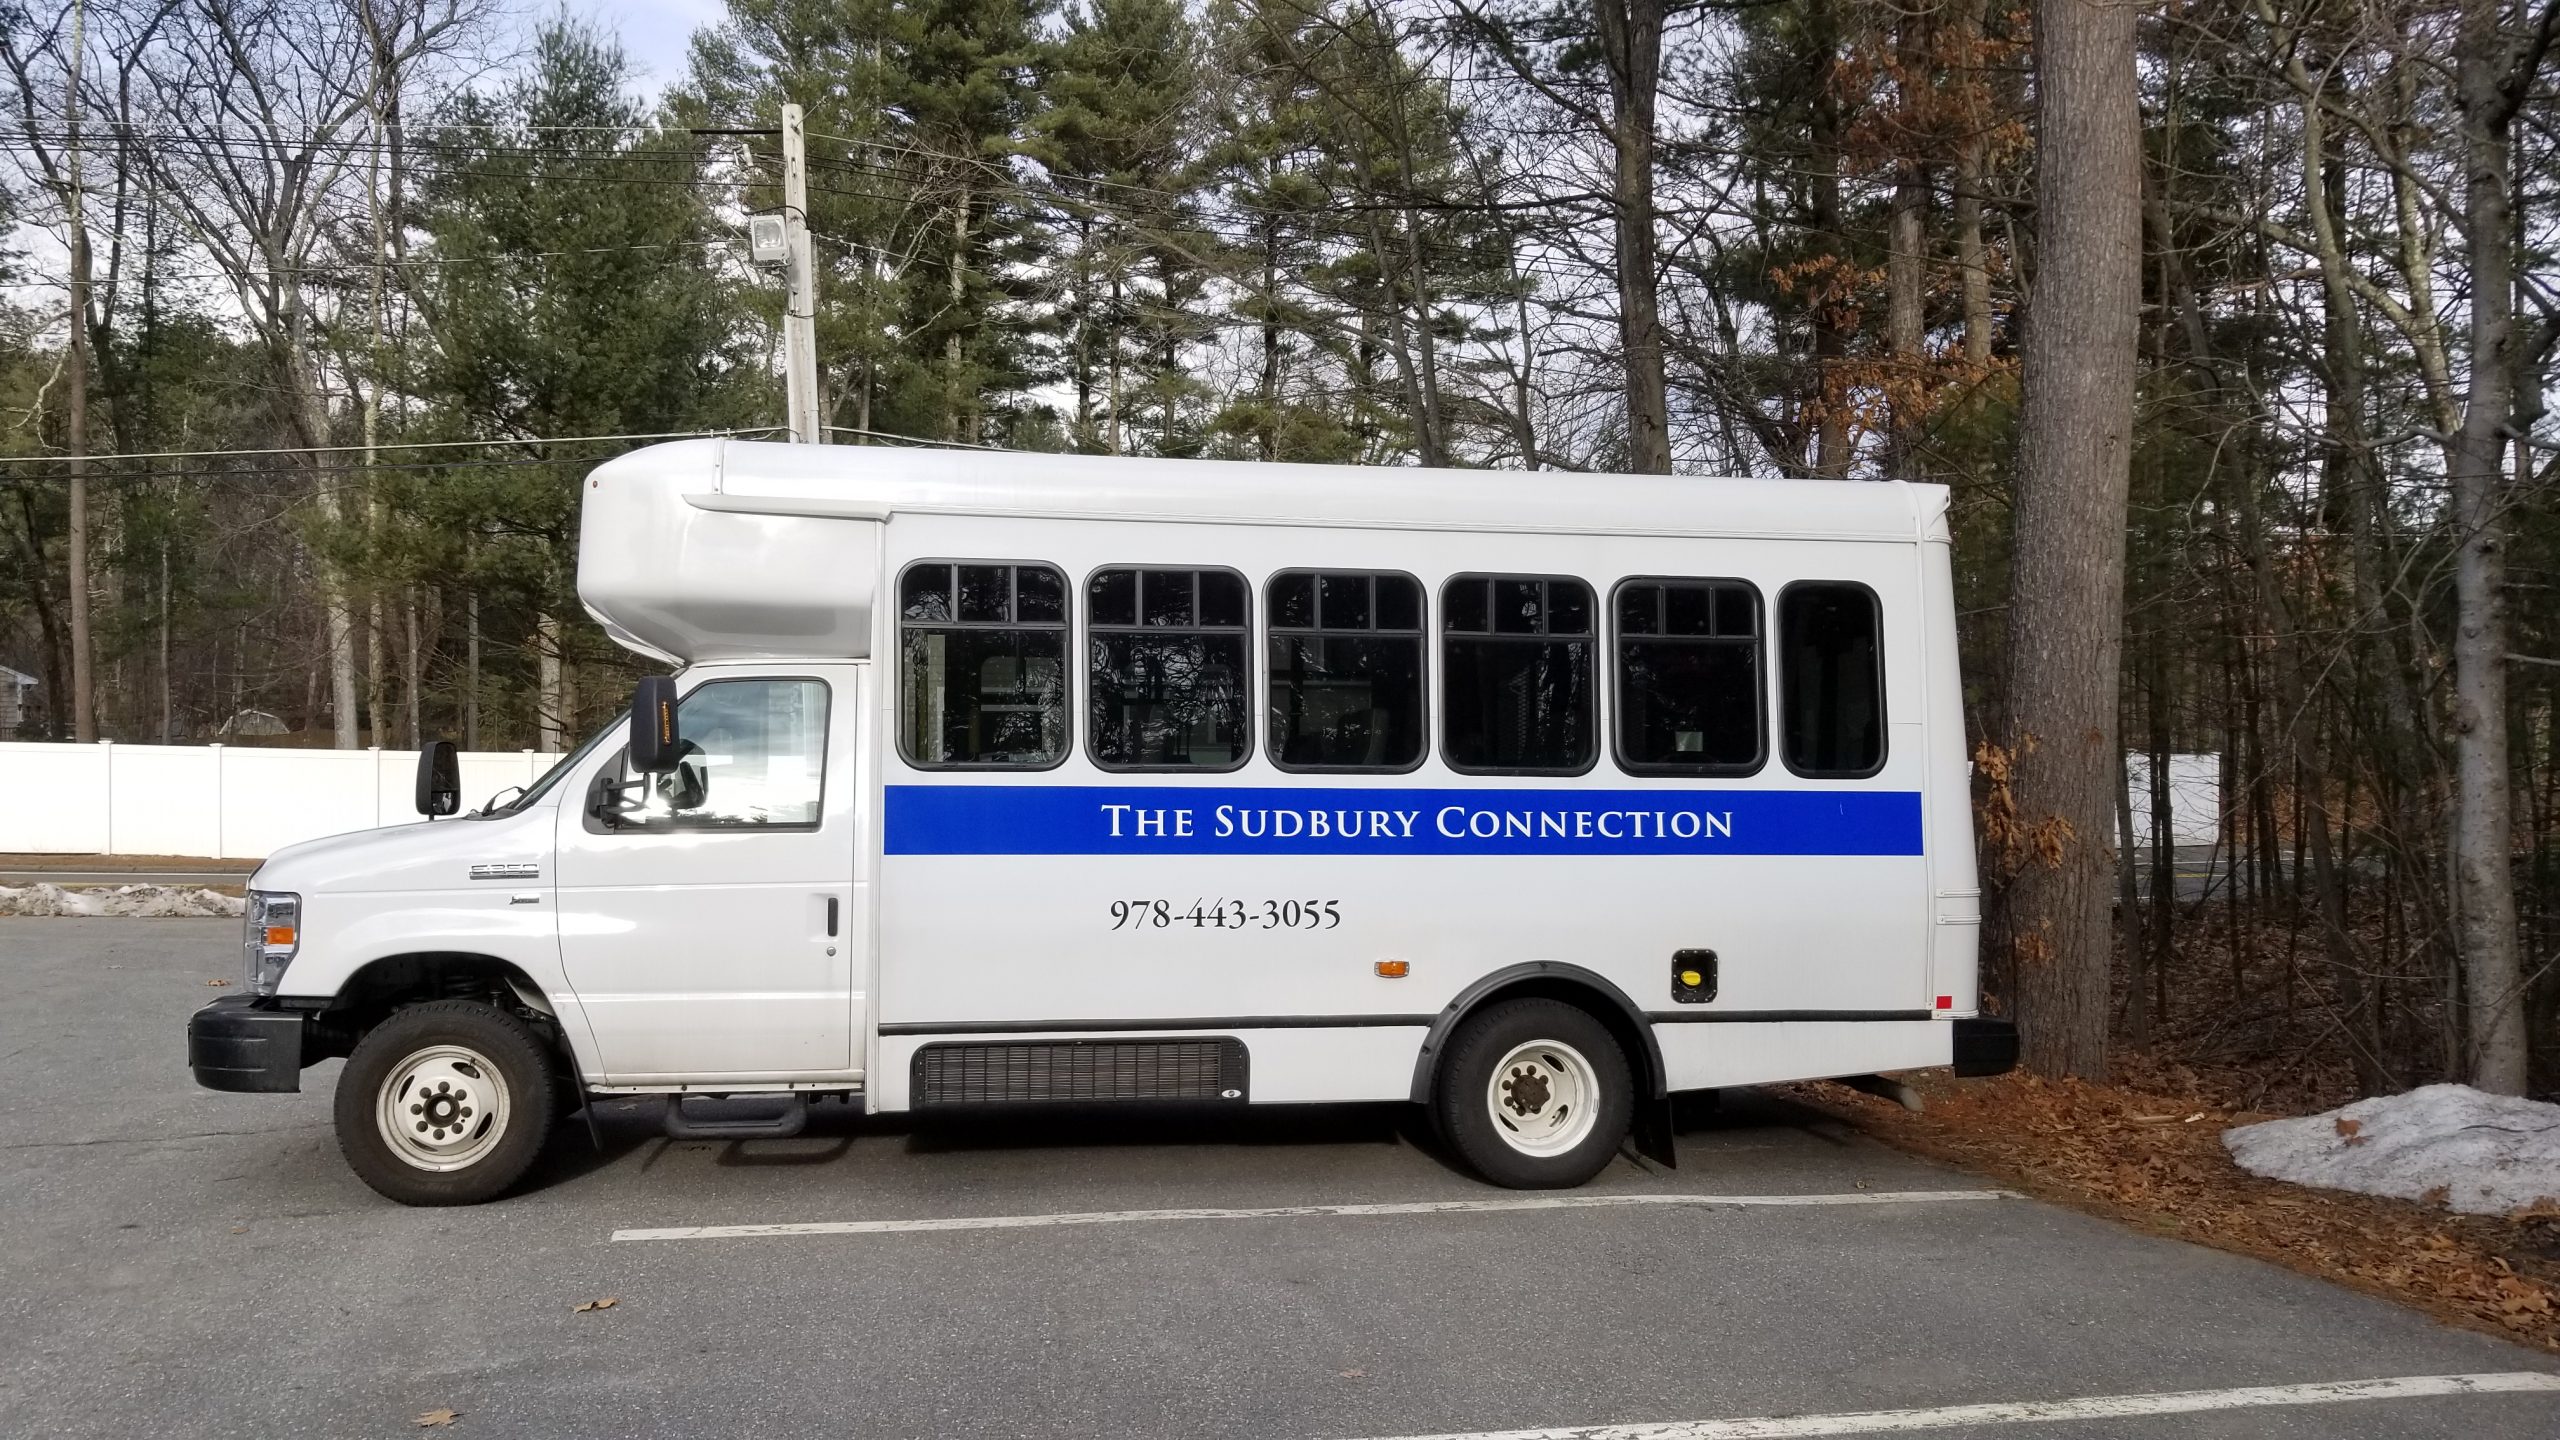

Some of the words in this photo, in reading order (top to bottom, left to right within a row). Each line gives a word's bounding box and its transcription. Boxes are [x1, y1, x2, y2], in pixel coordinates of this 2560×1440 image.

[1101, 805, 1193, 837] THE
[1216, 805, 1420, 838] SUDBURY
[1437, 805, 1733, 838] CONNECTION
[1110, 897, 1341, 931] 978-443-3055
